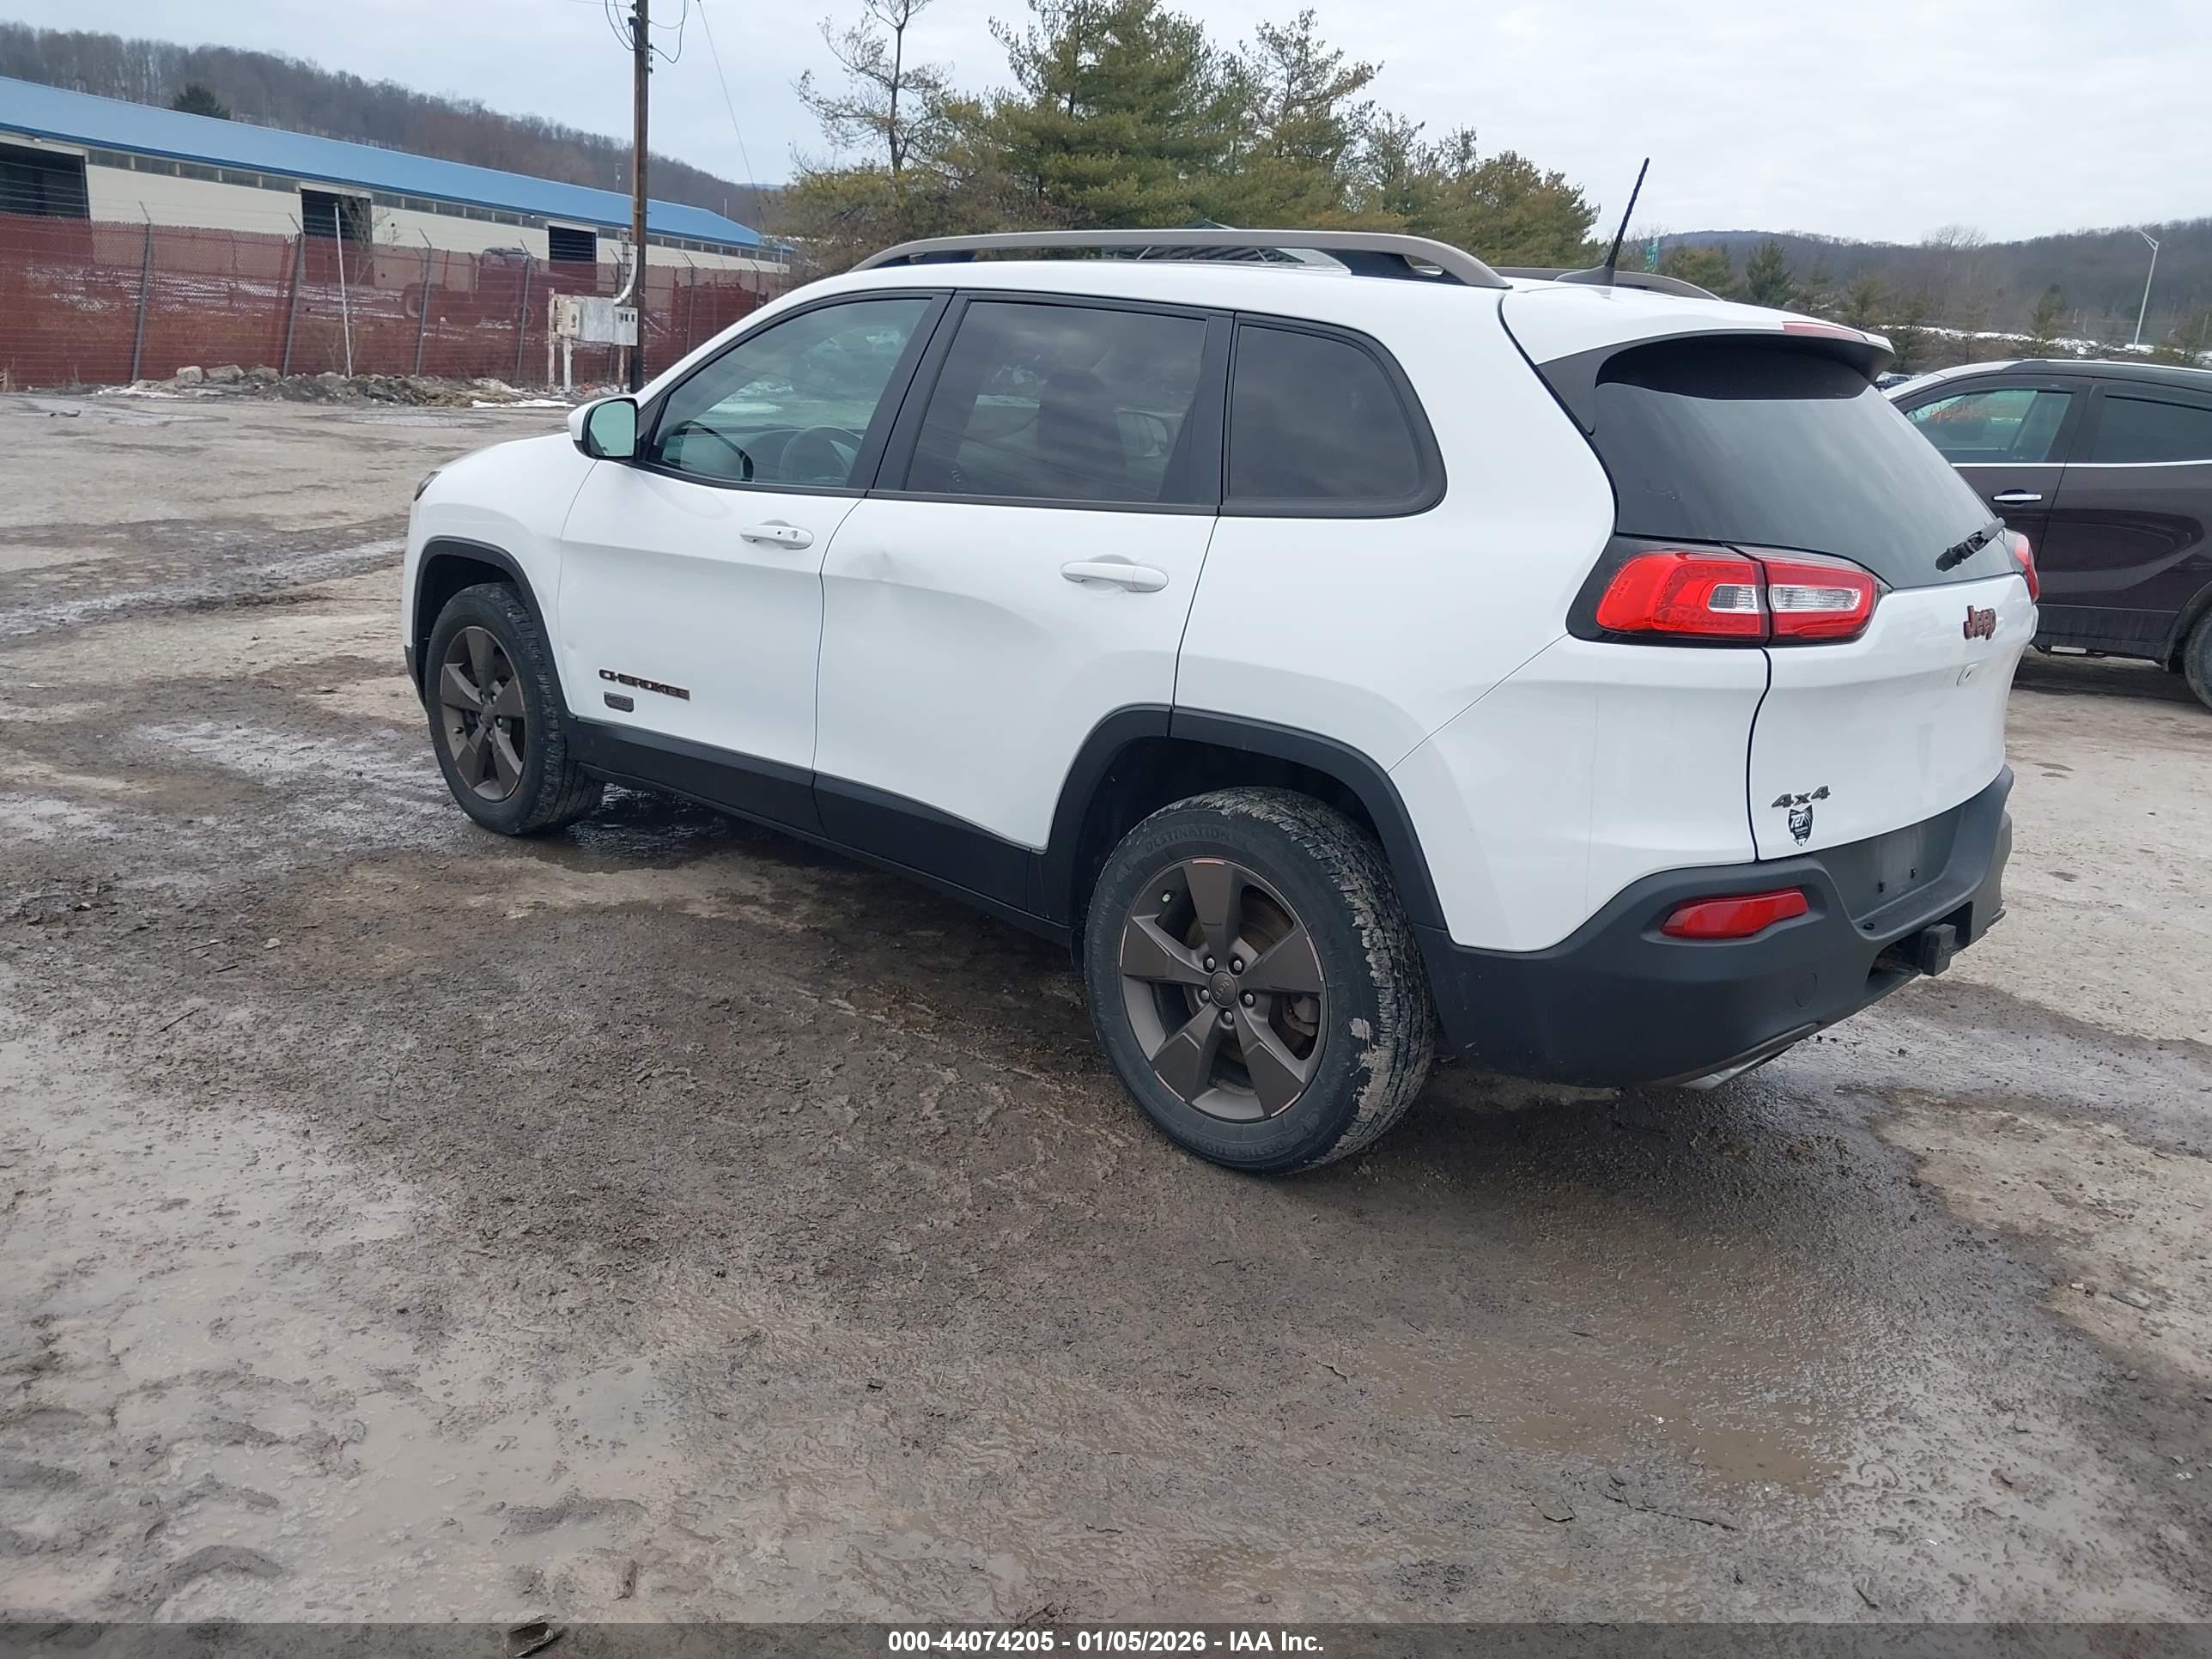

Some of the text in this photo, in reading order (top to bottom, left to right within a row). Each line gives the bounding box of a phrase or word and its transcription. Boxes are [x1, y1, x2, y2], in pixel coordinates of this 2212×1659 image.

[1964, 605, 1996, 641] Jeep
[599, 669, 690, 702] CHEROKEE
[1771, 785, 1831, 808] 4x4
